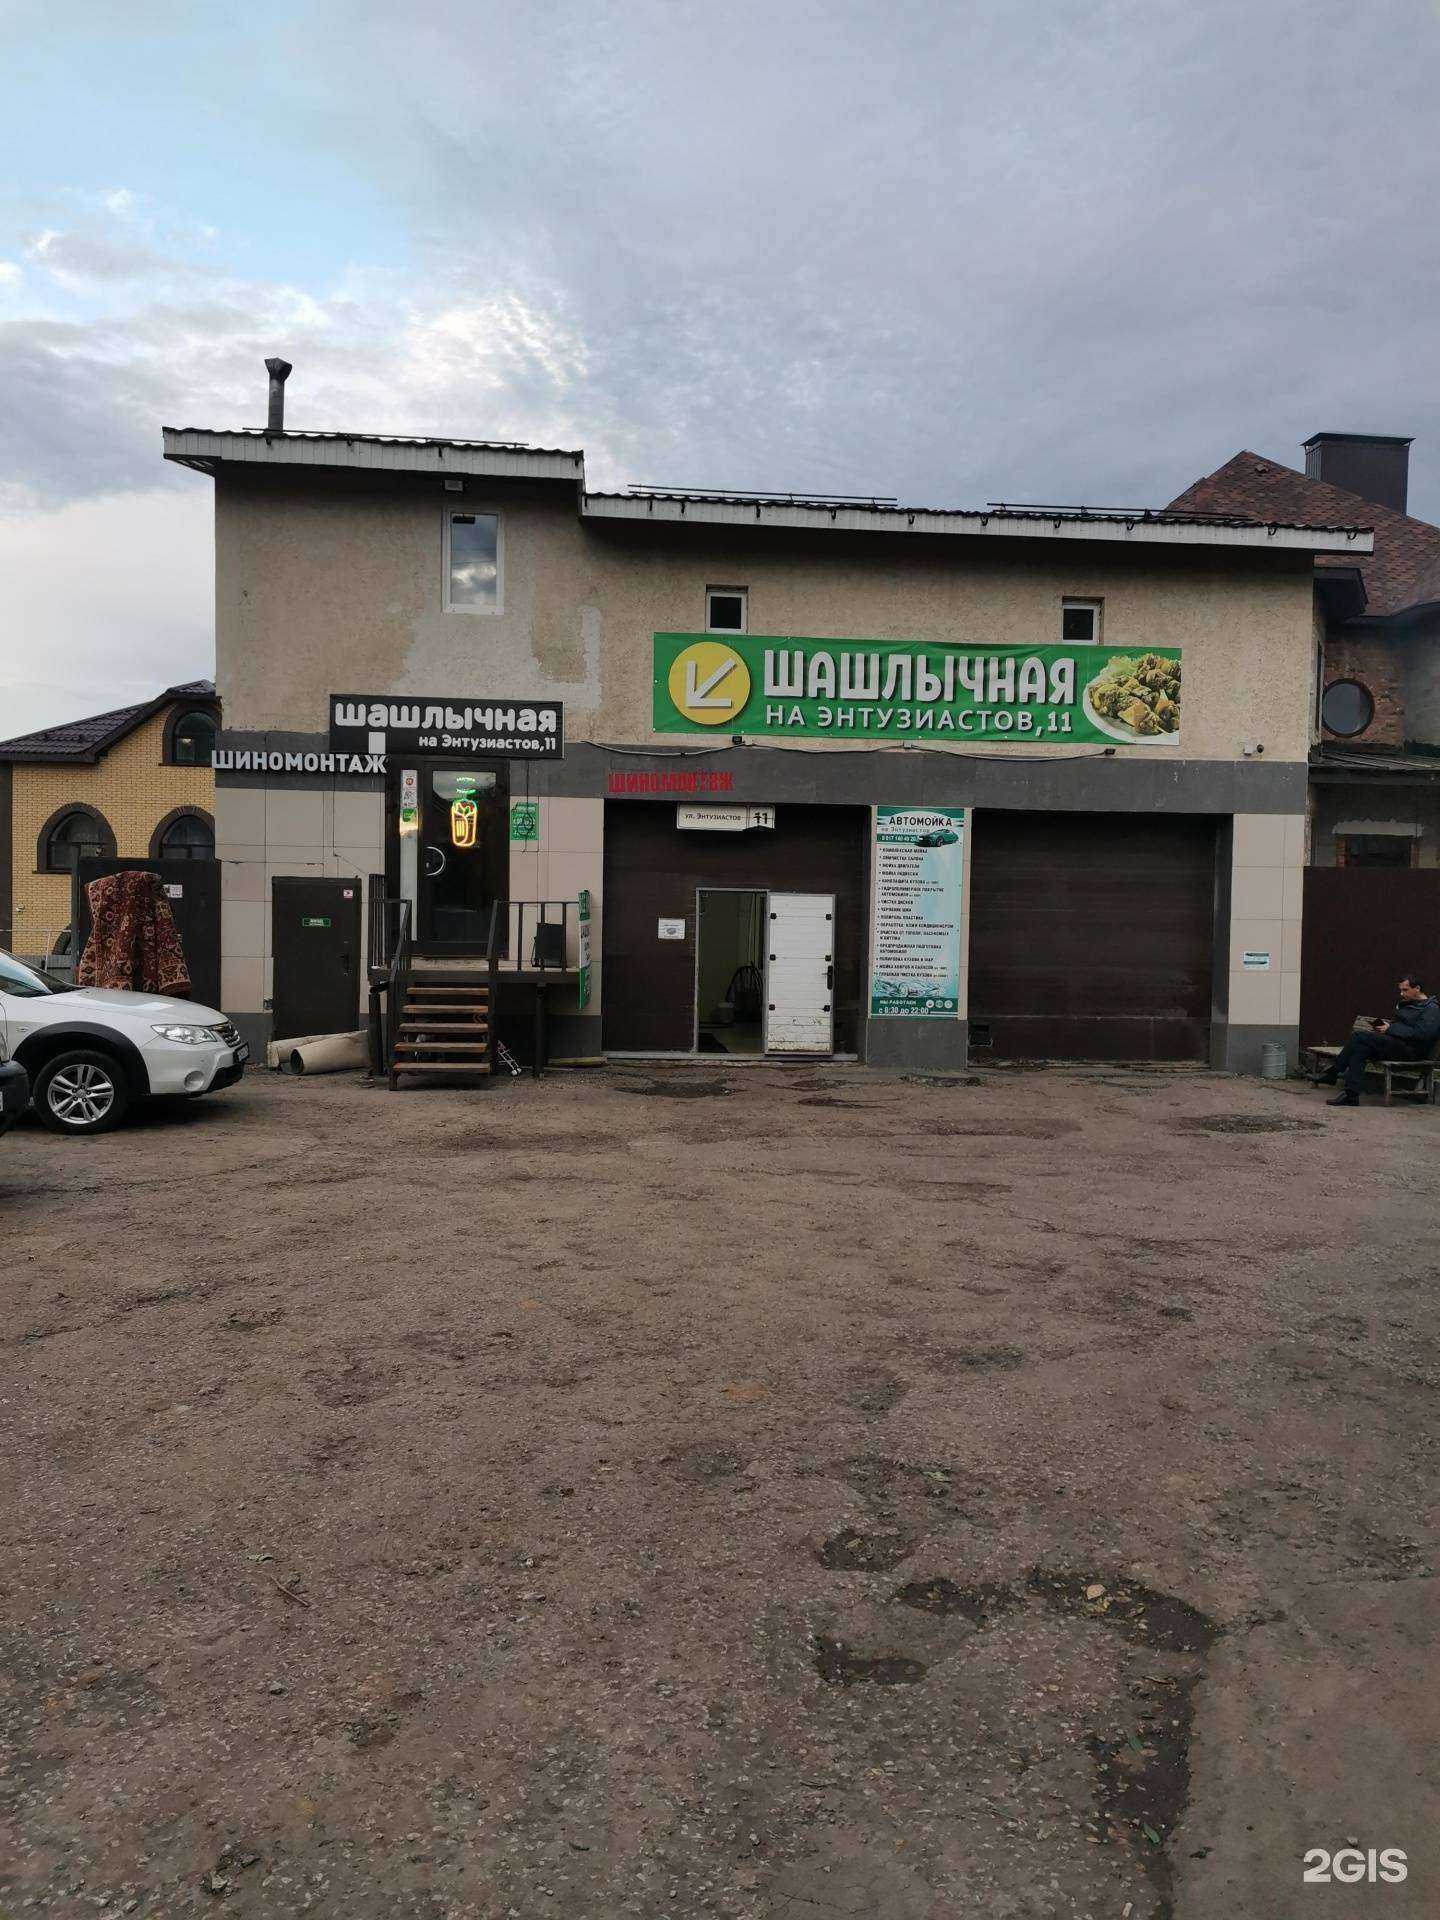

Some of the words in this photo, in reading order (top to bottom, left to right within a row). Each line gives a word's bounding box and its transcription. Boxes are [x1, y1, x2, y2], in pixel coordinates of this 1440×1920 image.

[764, 650, 1075, 704] ШАШЛЫЧНАЯ
[335, 702, 557, 733] шашлычная
[766, 705, 805, 725] НА
[817, 706, 1072, 737] ЭНТУЗИАСТОВ,11
[418, 736, 438, 747] на
[441, 734, 556, 752] Энтузиастов,11
[211, 750, 387, 773] ШИНОМОНТАЖ
[753, 812, 768, 825] 11
[889, 815, 953, 827] АВТОМОЙКА
